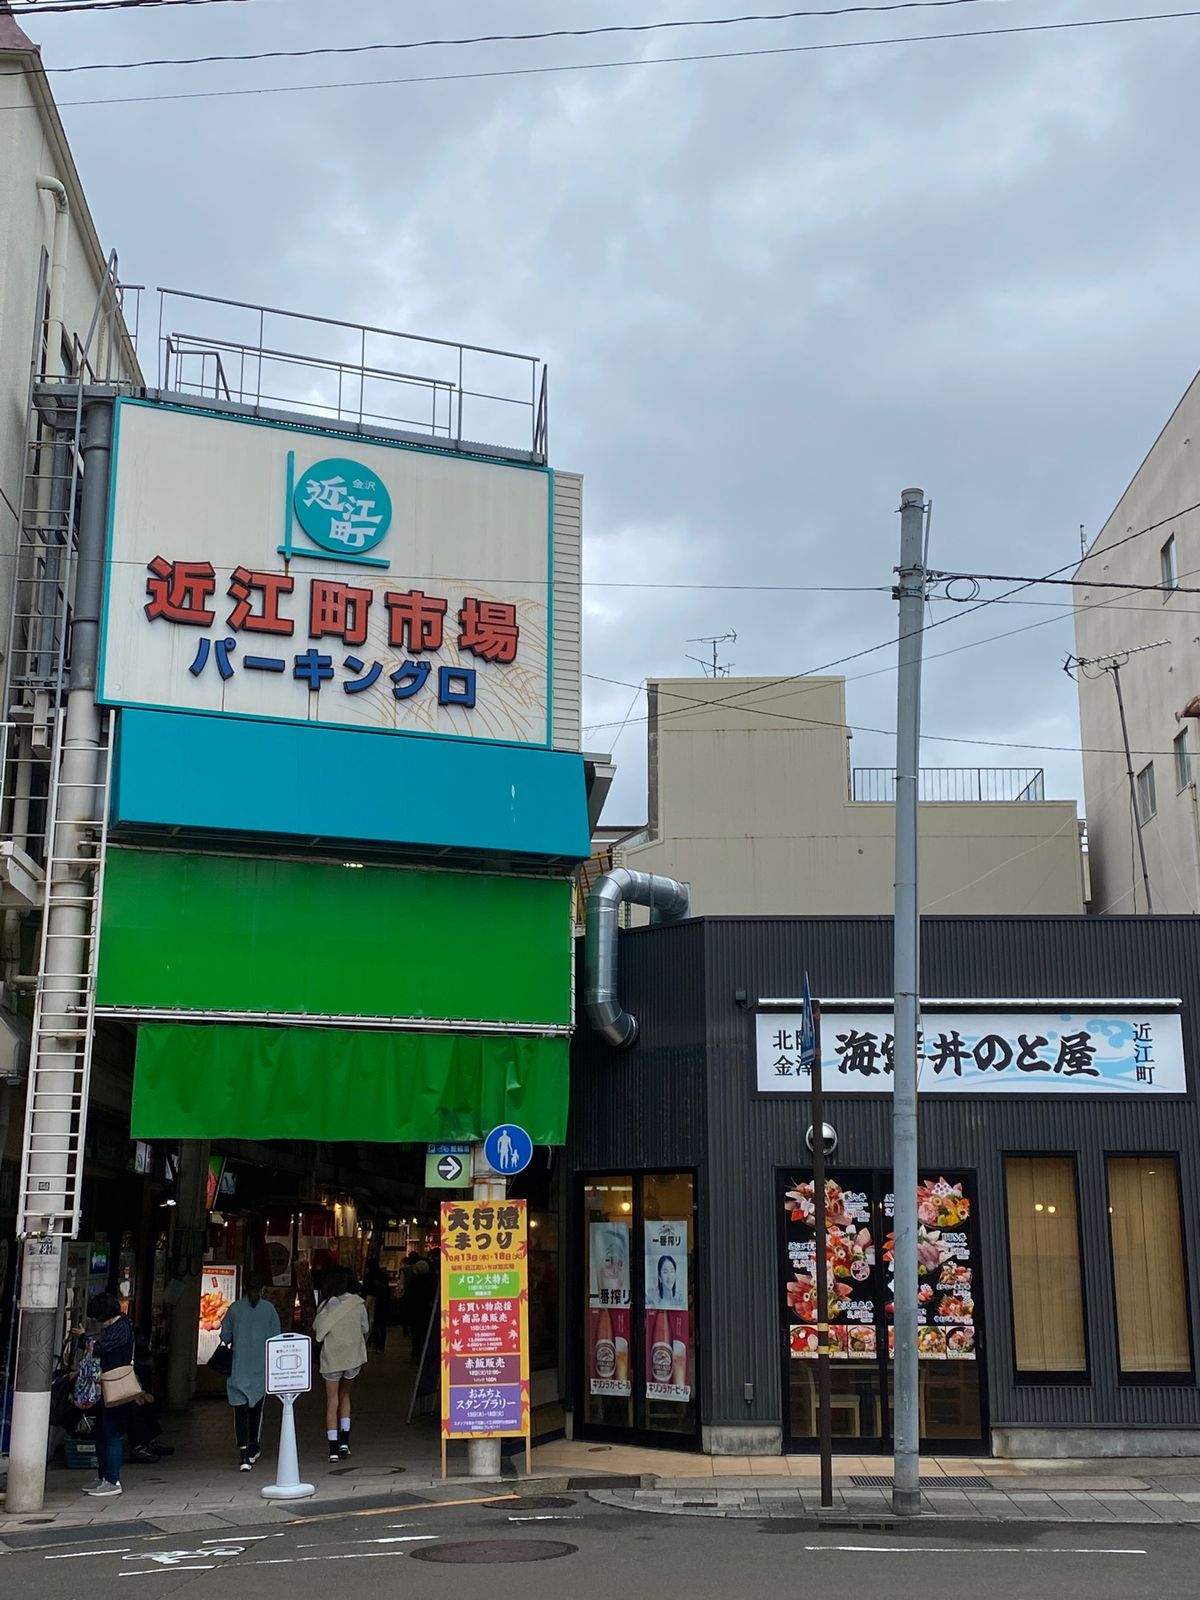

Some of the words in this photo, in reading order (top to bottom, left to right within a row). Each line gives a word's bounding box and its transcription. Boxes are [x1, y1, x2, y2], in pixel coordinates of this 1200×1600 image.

[302, 475, 385, 548] 近江町
[352, 477, 377, 491] 金沢
[143, 554, 521, 664] 近江町市場
[1132, 1022, 1157, 1086] 近江町
[455, 1231, 513, 1251] まつり
